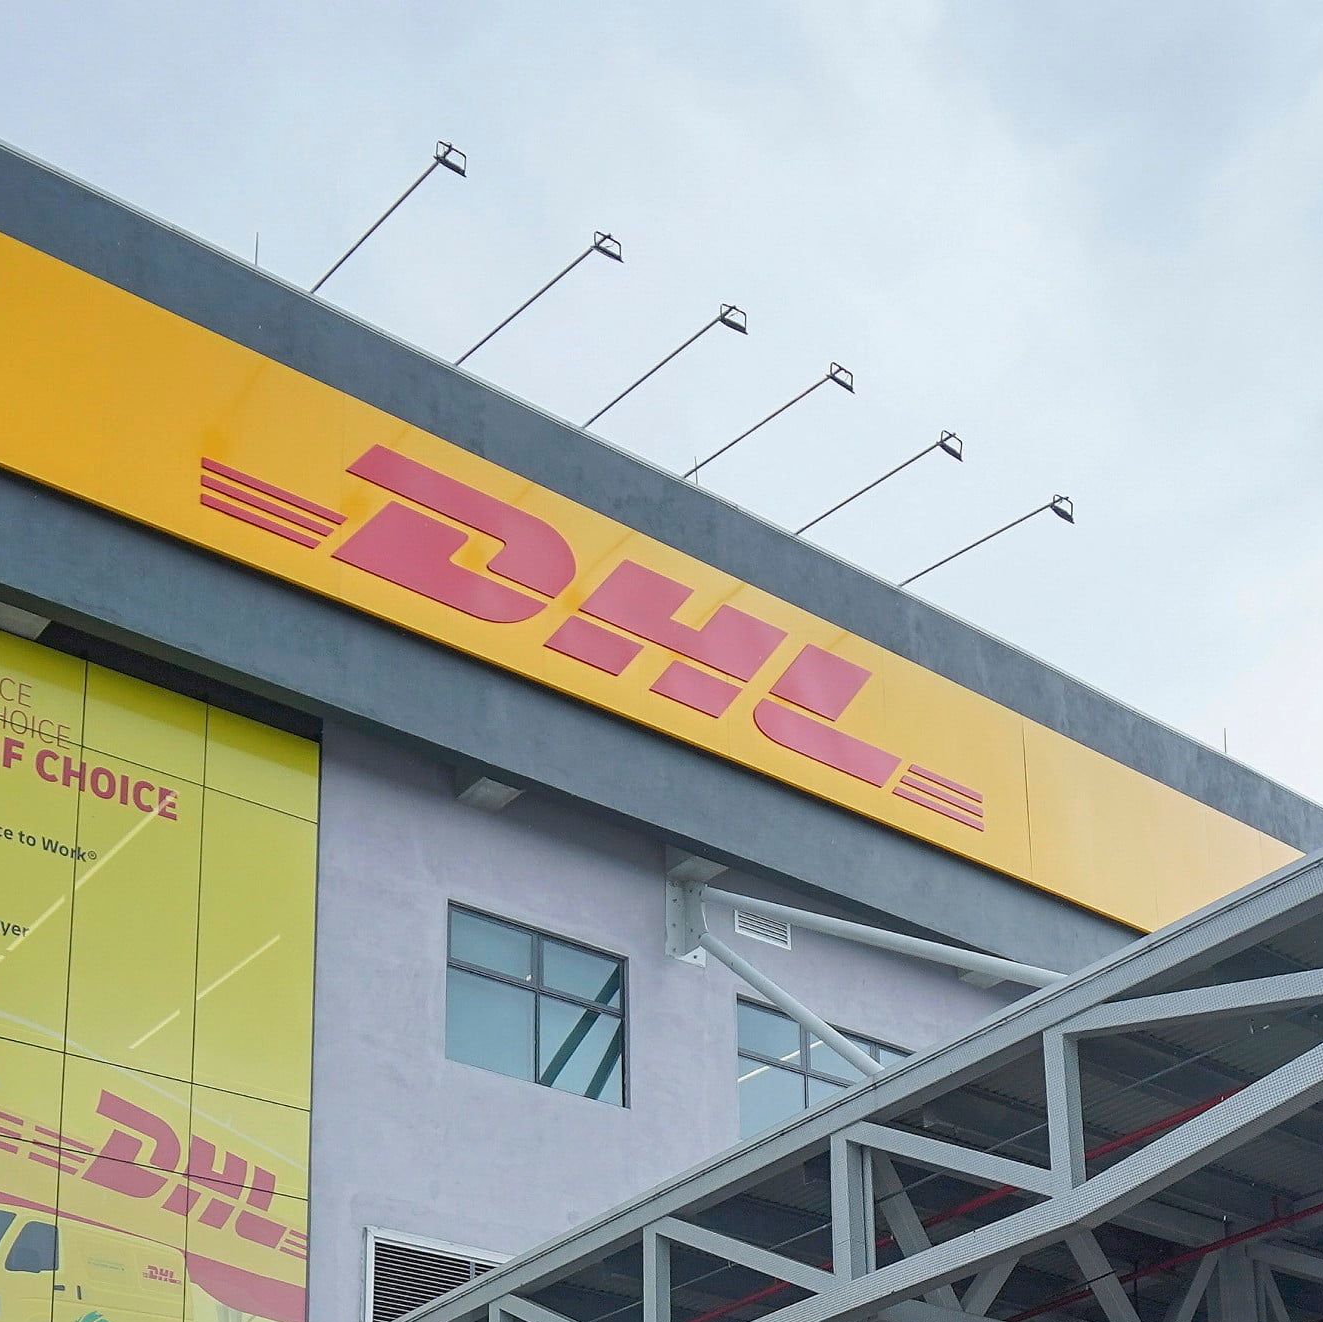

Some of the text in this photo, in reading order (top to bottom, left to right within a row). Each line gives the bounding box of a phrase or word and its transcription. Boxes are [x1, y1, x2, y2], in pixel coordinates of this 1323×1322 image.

[330, 444, 900, 788] DHL
[35, 749, 178, 821] CHOICE
[18, 830, 36, 847] to
[82, 1089, 287, 1249] DHL
[147, 1265, 179, 1284] DHL
